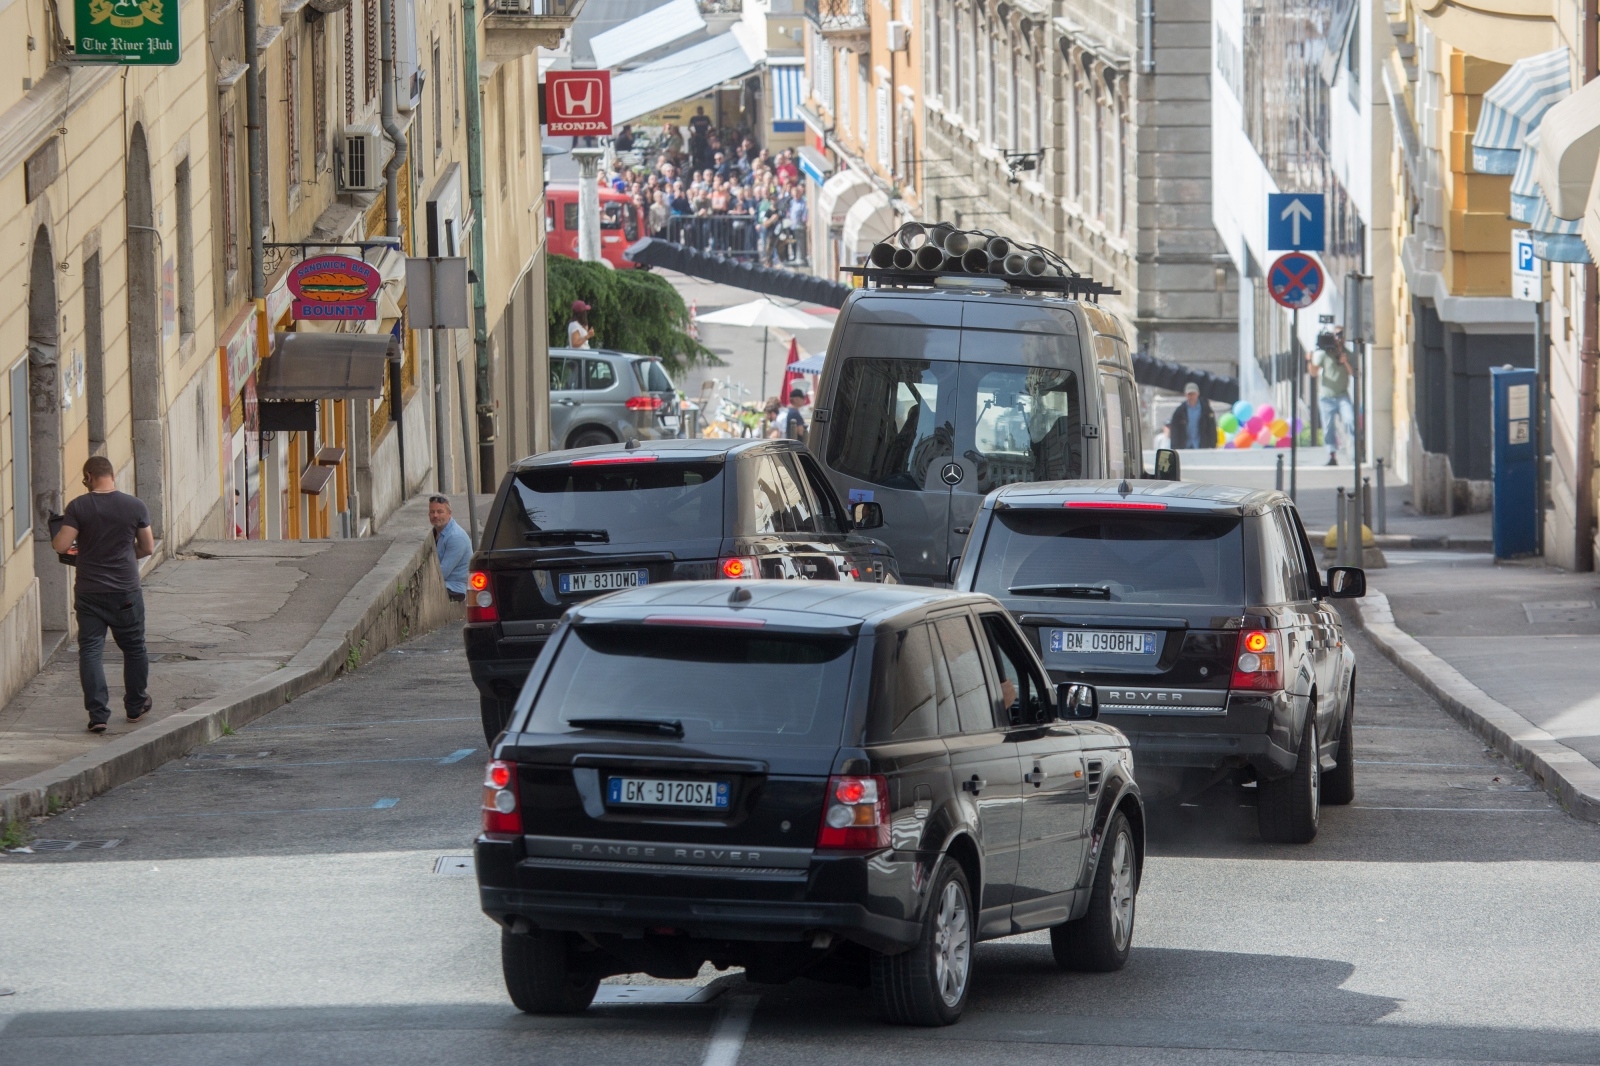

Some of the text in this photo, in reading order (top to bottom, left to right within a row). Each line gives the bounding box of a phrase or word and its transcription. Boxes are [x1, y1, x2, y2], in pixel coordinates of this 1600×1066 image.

[82, 37, 173, 55] The River Pub
[550, 121, 609, 131] HONDA
[1520, 245, 1532, 268] P
[297, 261, 371, 277] SANDWICH BAR
[302, 305, 366, 317] BOUNTY
[1109, 691, 1183, 701] ROVER
[716, 796, 727, 805] TS
[571, 844, 761, 861] RANGE ROVER
